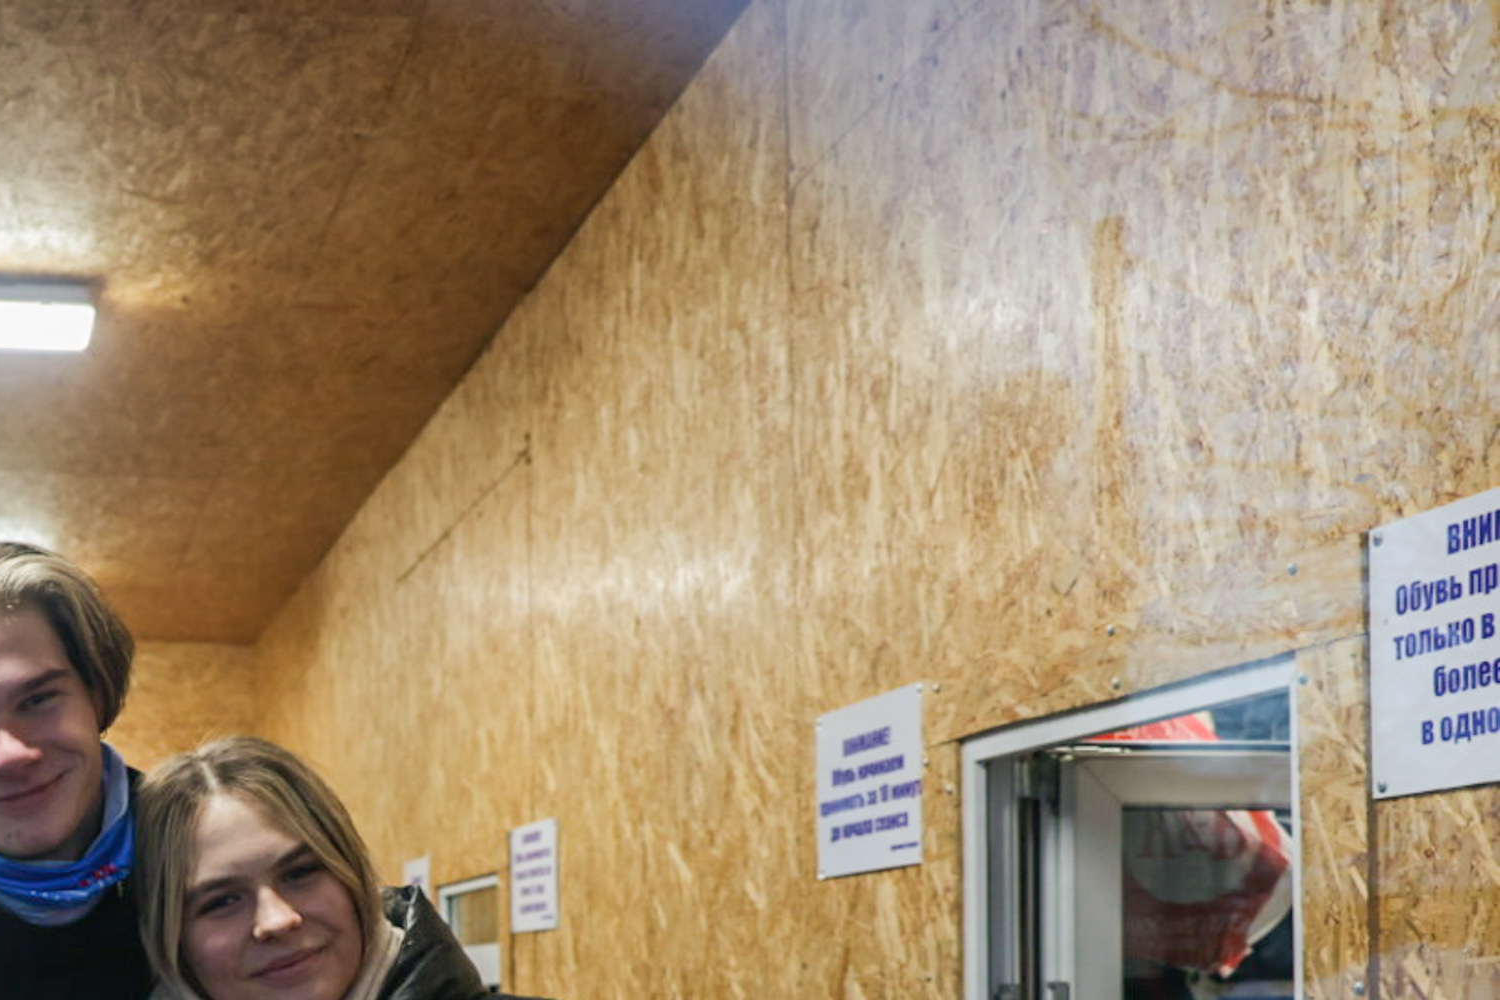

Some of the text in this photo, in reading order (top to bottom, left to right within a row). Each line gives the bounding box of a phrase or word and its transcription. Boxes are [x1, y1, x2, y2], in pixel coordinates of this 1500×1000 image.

[1396, 575, 1463, 616] Обувь
[1393, 612, 1495, 660] только в
[1422, 707, 1500, 745] в одно
